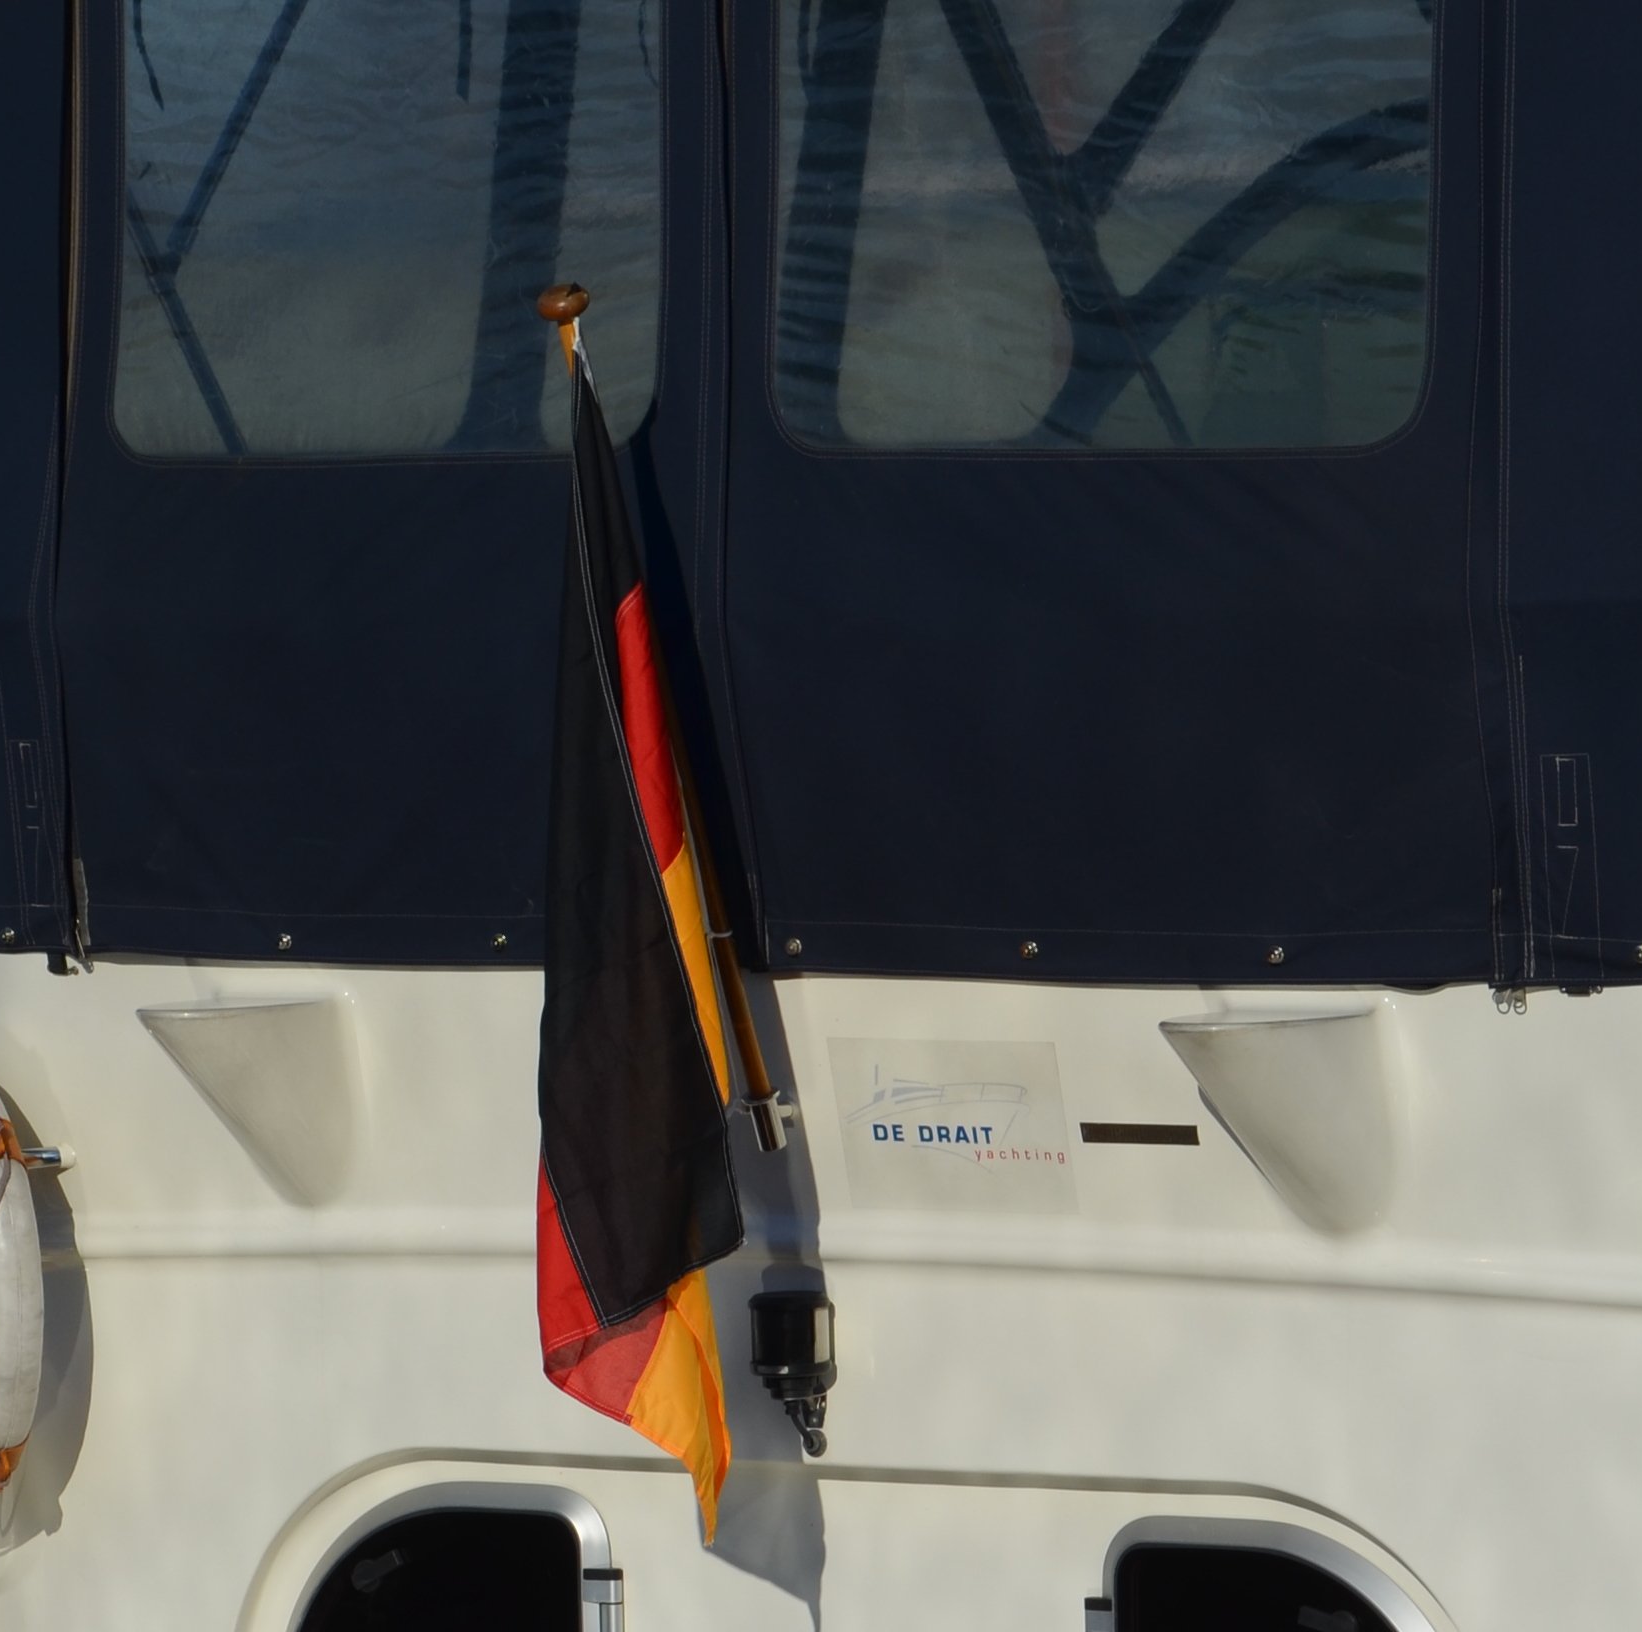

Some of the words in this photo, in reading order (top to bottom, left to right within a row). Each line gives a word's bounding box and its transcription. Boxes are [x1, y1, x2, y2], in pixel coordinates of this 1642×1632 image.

[872, 1123, 905, 1142] DE
[917, 1125, 993, 1144] DRAIT
[974, 1148, 1065, 1164] yachting
